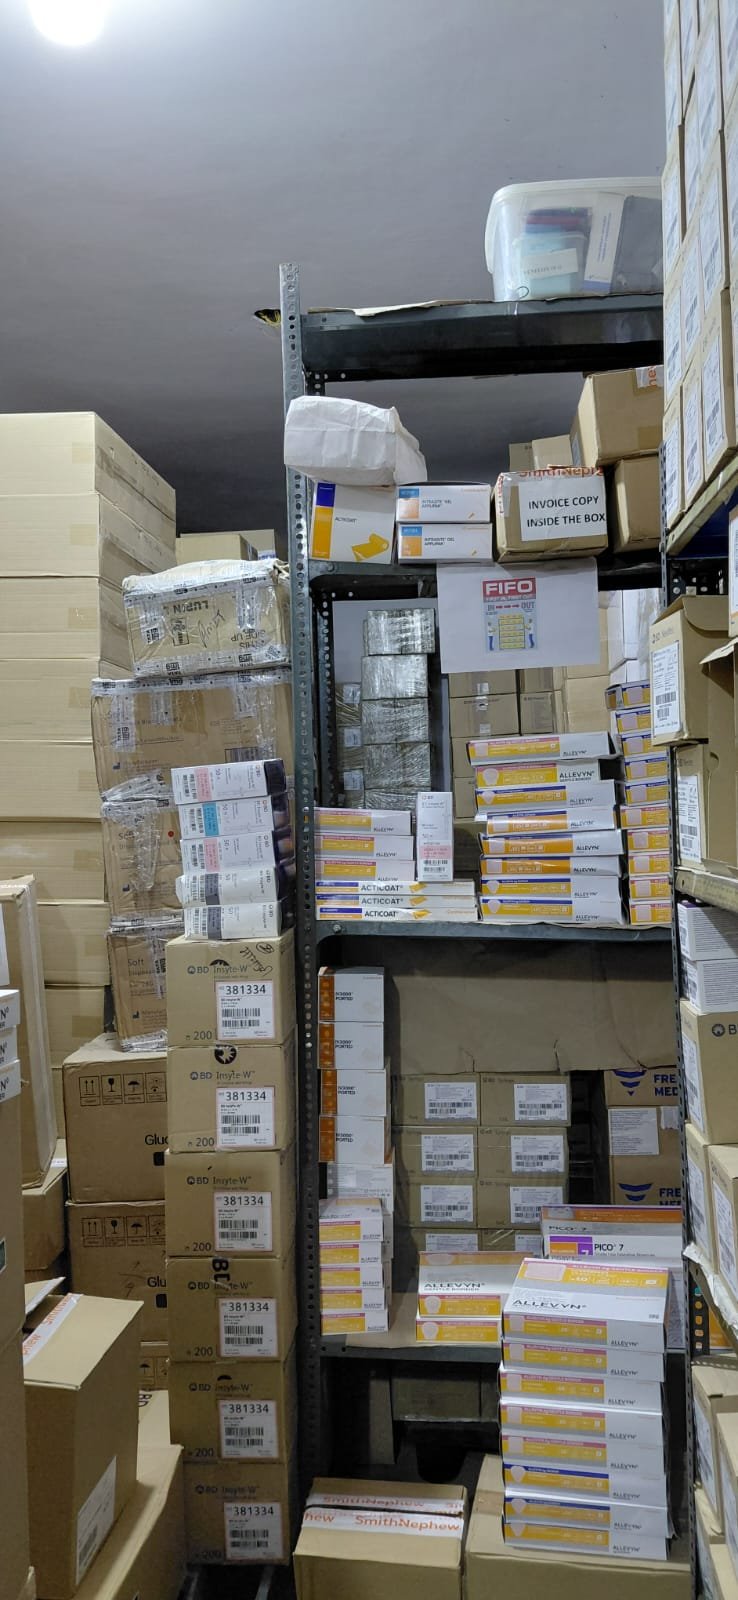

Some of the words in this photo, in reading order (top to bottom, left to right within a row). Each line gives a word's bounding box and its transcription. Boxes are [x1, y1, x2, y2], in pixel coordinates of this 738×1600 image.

[528, 499, 570, 510] INVOICE
[572, 496, 599, 506] COPY
[527, 517, 560, 528] INSIDE
[563, 515, 582, 525] THE
[584, 512, 606, 522] BOX
[485, 580, 533, 595] FIFO
[487, 604, 495, 612] IN
[521, 601, 535, 609] OUT
[559, 770, 592, 779] ALLEVYN
[361, 884, 400, 892] ACTICOAT
[361, 897, 400, 905] ACTICOAT
[364, 910, 397, 918] ACTICOAT
[197, 966, 210, 974] BD
[225, 984, 266, 996] 381334
[193, 1031, 213, 1041] 200
[199, 1072, 213, 1080] BD
[653, 1074, 677, 1084] FRE
[225, 1090, 267, 1101] 381334
[195, 1137, 215, 1147] 200
[197, 1176, 209, 1185] BD
[659, 1187, 681, 1197] FRE
[223, 1196, 264, 1206] 381334
[192, 1242, 212, 1252] 200
[594, 1243, 613, 1251] PICO
[619, 1243, 624, 1251] 7
[197, 1282, 210, 1290] BD
[228, 1302, 269, 1312] 381334
[513, 1299, 582, 1310] ALLEVYN
[194, 1346, 213, 1357] 200
[228, 1403, 269, 1414] 381334
[194, 1448, 214, 1458] 200
[233, 1506, 274, 1516] 381334
[304, 1512, 336, 1524] hew
[354, 1515, 461, 1532] SmithNephew
